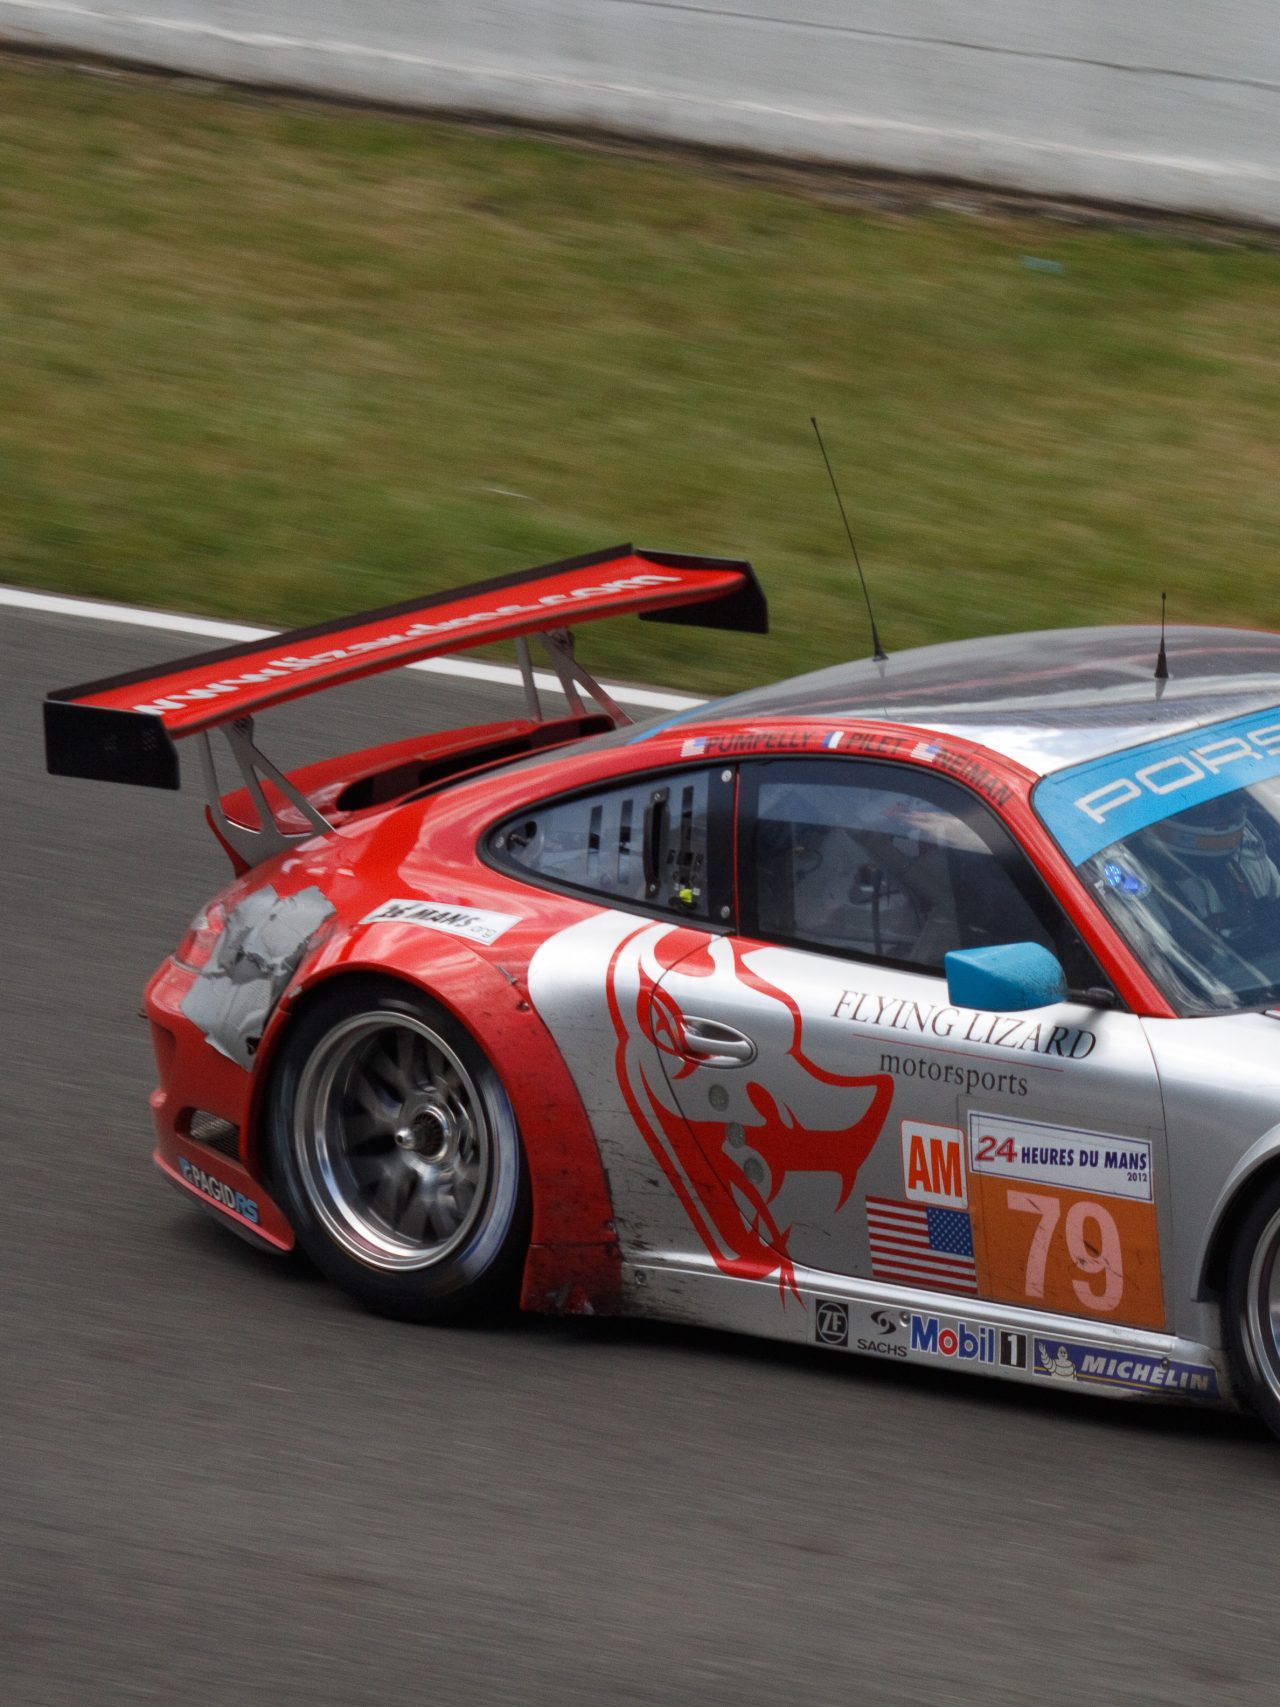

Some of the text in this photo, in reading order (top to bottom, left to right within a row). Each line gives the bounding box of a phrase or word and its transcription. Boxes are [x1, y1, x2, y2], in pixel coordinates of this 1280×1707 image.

[704, 730, 1016, 808] PUMPELLY PILET NEIMAN
[831, 989, 1097, 1061] FLYING LIZARD
[880, 1053, 1028, 1097] motorsports
[908, 1135, 963, 1198] AM
[974, 1135, 1147, 1171] 24 HEURES DU MANS
[190, 1164, 236, 1209] PAGID
[1127, 1171, 1148, 1183] 2012
[1007, 1189, 1124, 1312] 79
[819, 1308, 845, 1338] ZF
[910, 1313, 996, 1366] Mobil
[857, 1338, 908, 1358] SACHS
[1080, 1354, 1209, 1392] MICHELIN
